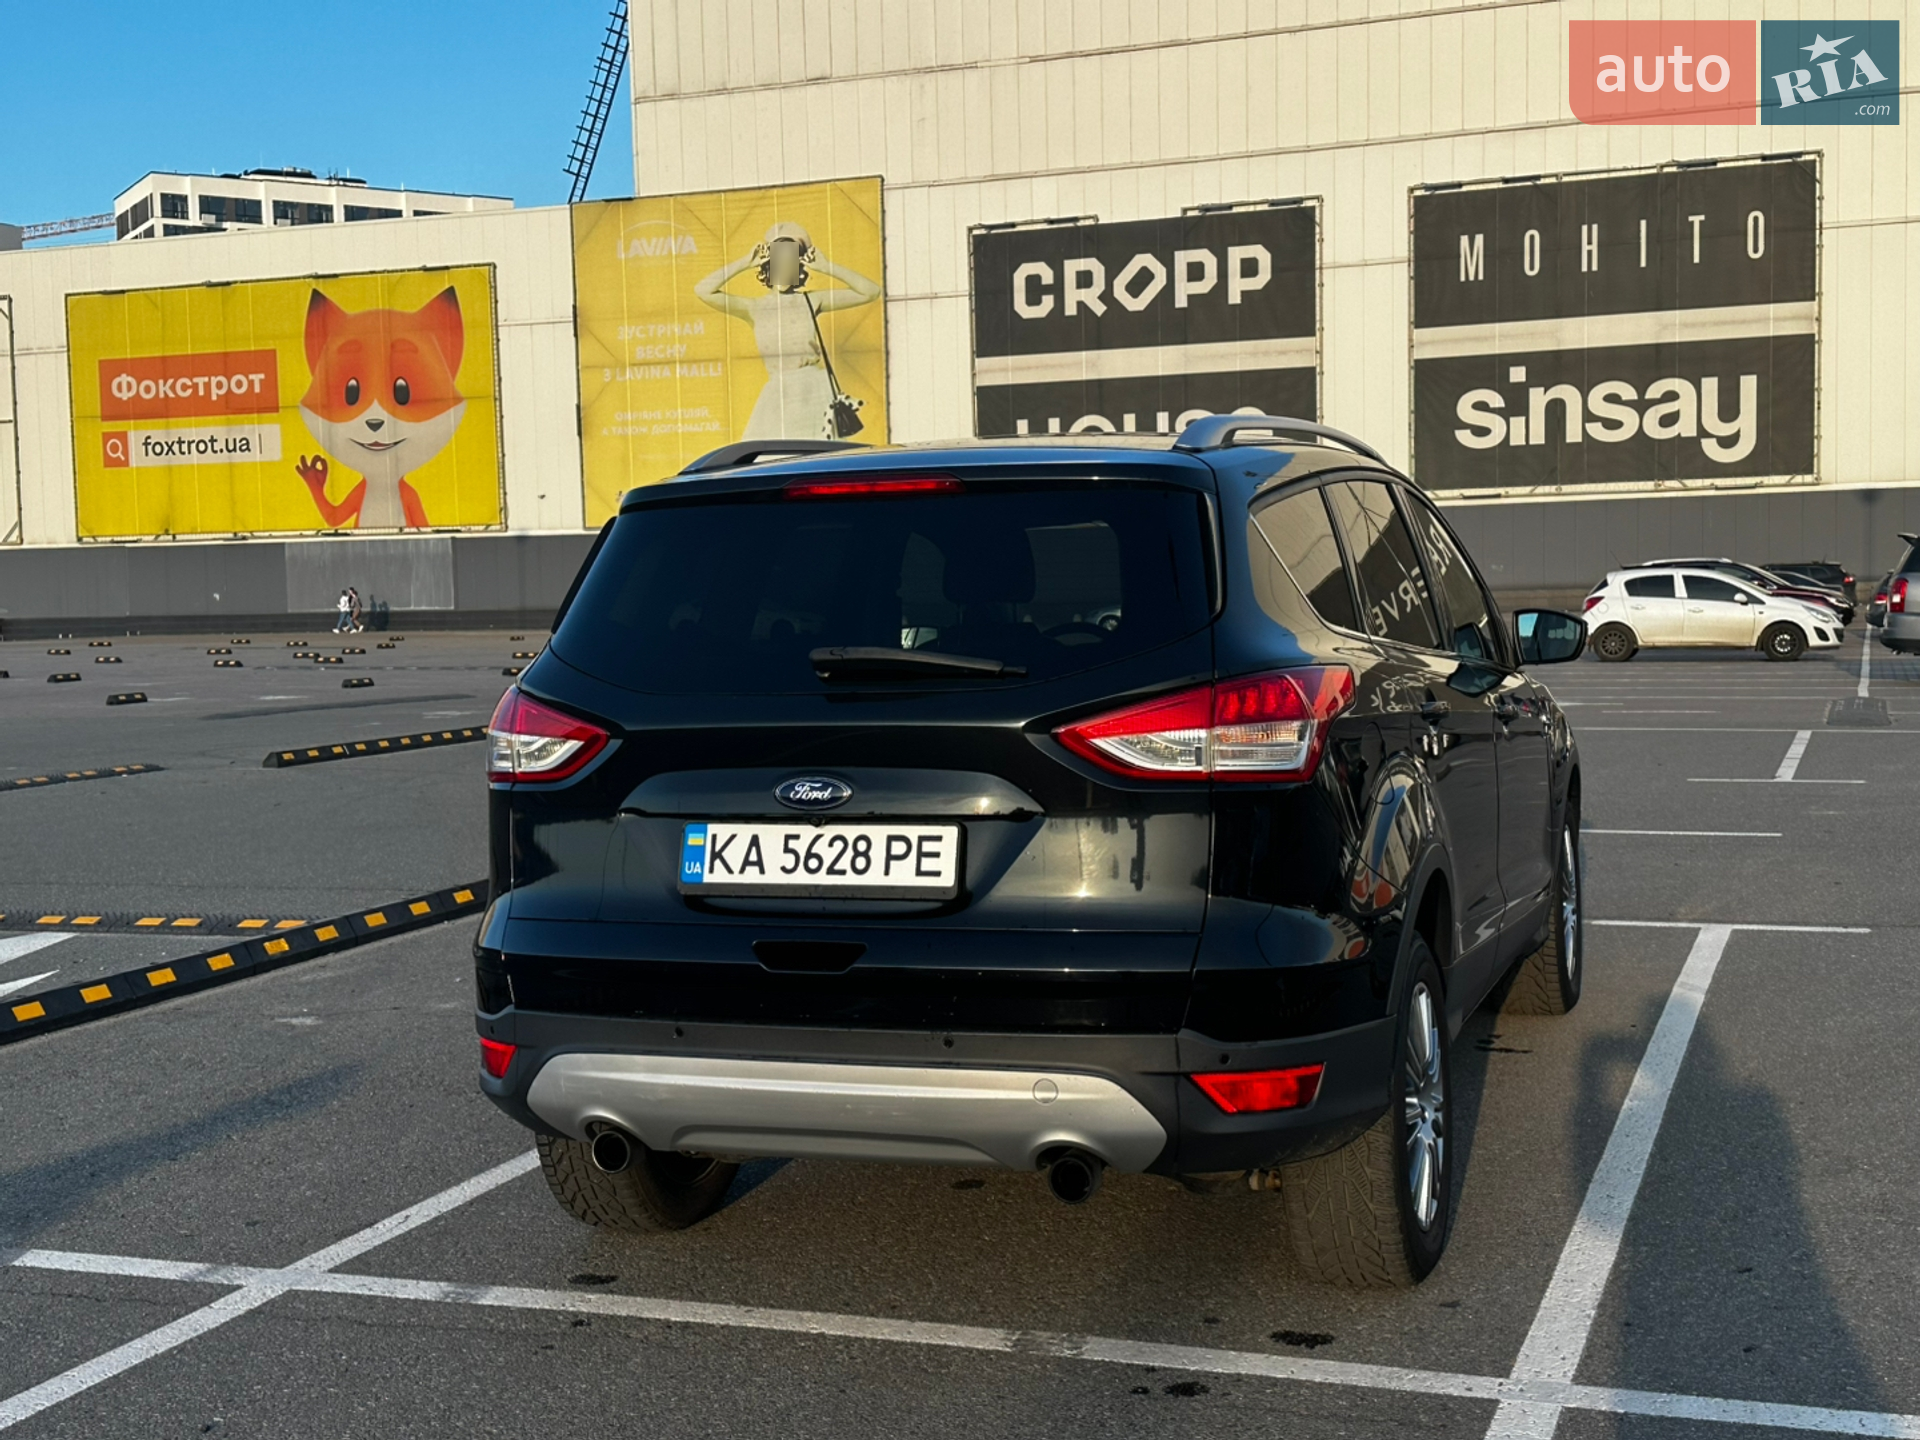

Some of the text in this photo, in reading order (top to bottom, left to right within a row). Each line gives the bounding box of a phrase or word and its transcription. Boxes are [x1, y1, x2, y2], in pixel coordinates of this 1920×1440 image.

[616, 234, 699, 260] LAVINA
[1459, 210, 1765, 282] MOHITO
[1013, 243, 1272, 320] CROPP
[616, 318, 705, 340] ЗУСТРІЧАЙ
[635, 343, 687, 360] ВЕСНУ
[615, 365, 672, 382] LAVINA
[676, 362, 722, 377] MALL!
[111, 372, 265, 400] Фокстрот
[1454, 365, 1758, 463] sinsay
[142, 434, 251, 457] foxtrot.ua
[790, 782, 832, 801] Ford
[708, 833, 943, 877] KA 5628 PE
[685, 861, 702, 874] UA
